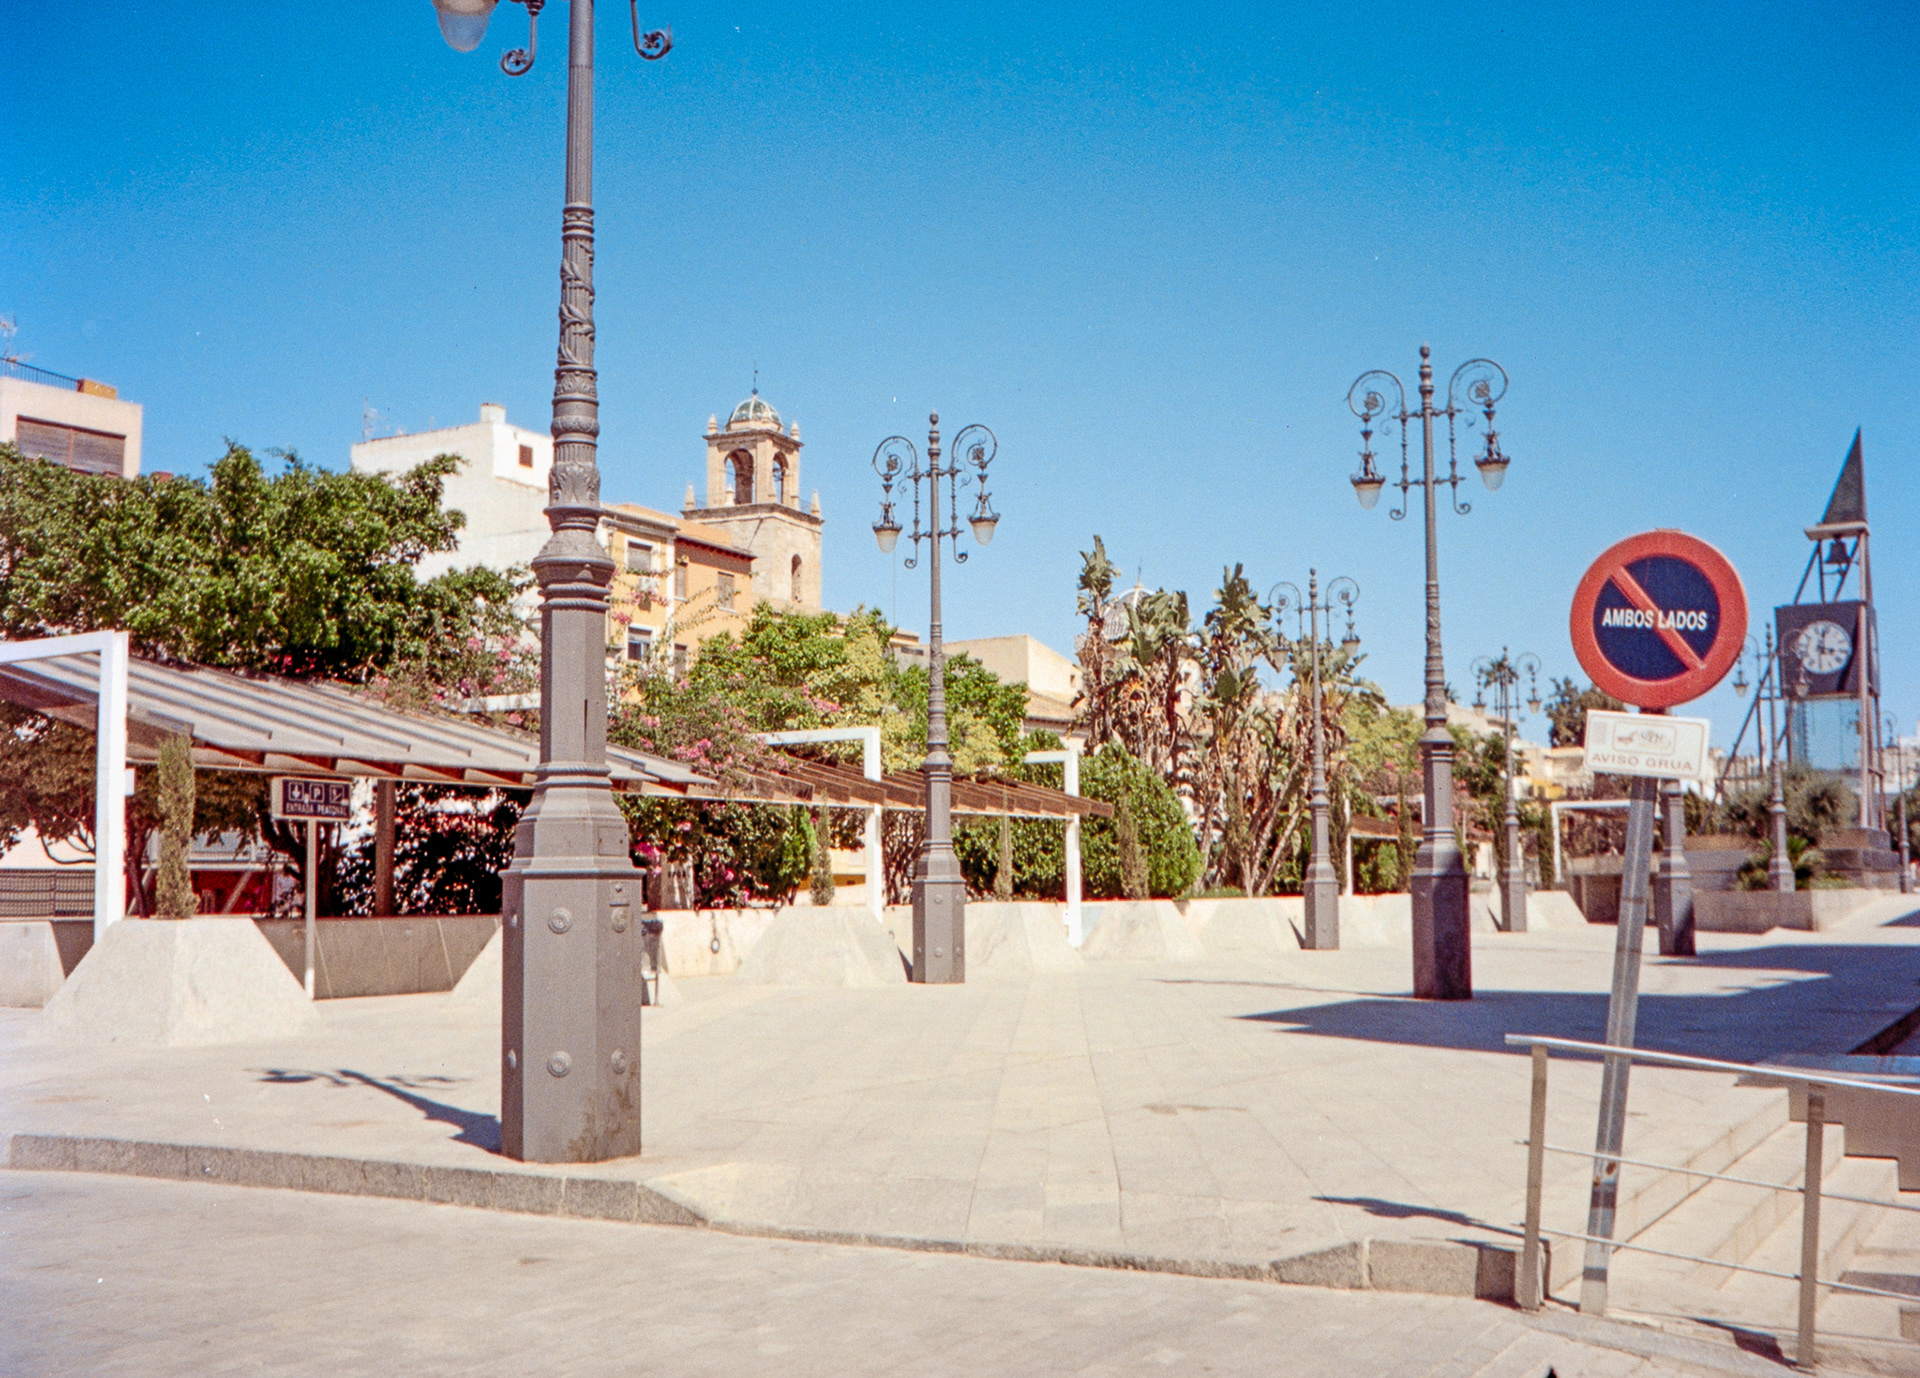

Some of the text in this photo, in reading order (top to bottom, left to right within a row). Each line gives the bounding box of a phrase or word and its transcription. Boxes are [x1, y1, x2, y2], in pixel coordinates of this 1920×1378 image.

[1602, 609, 1708, 630] AMBOS LADOS
[1591, 753, 1692, 772] AVISO GRUA
[313, 787, 321, 799] P
